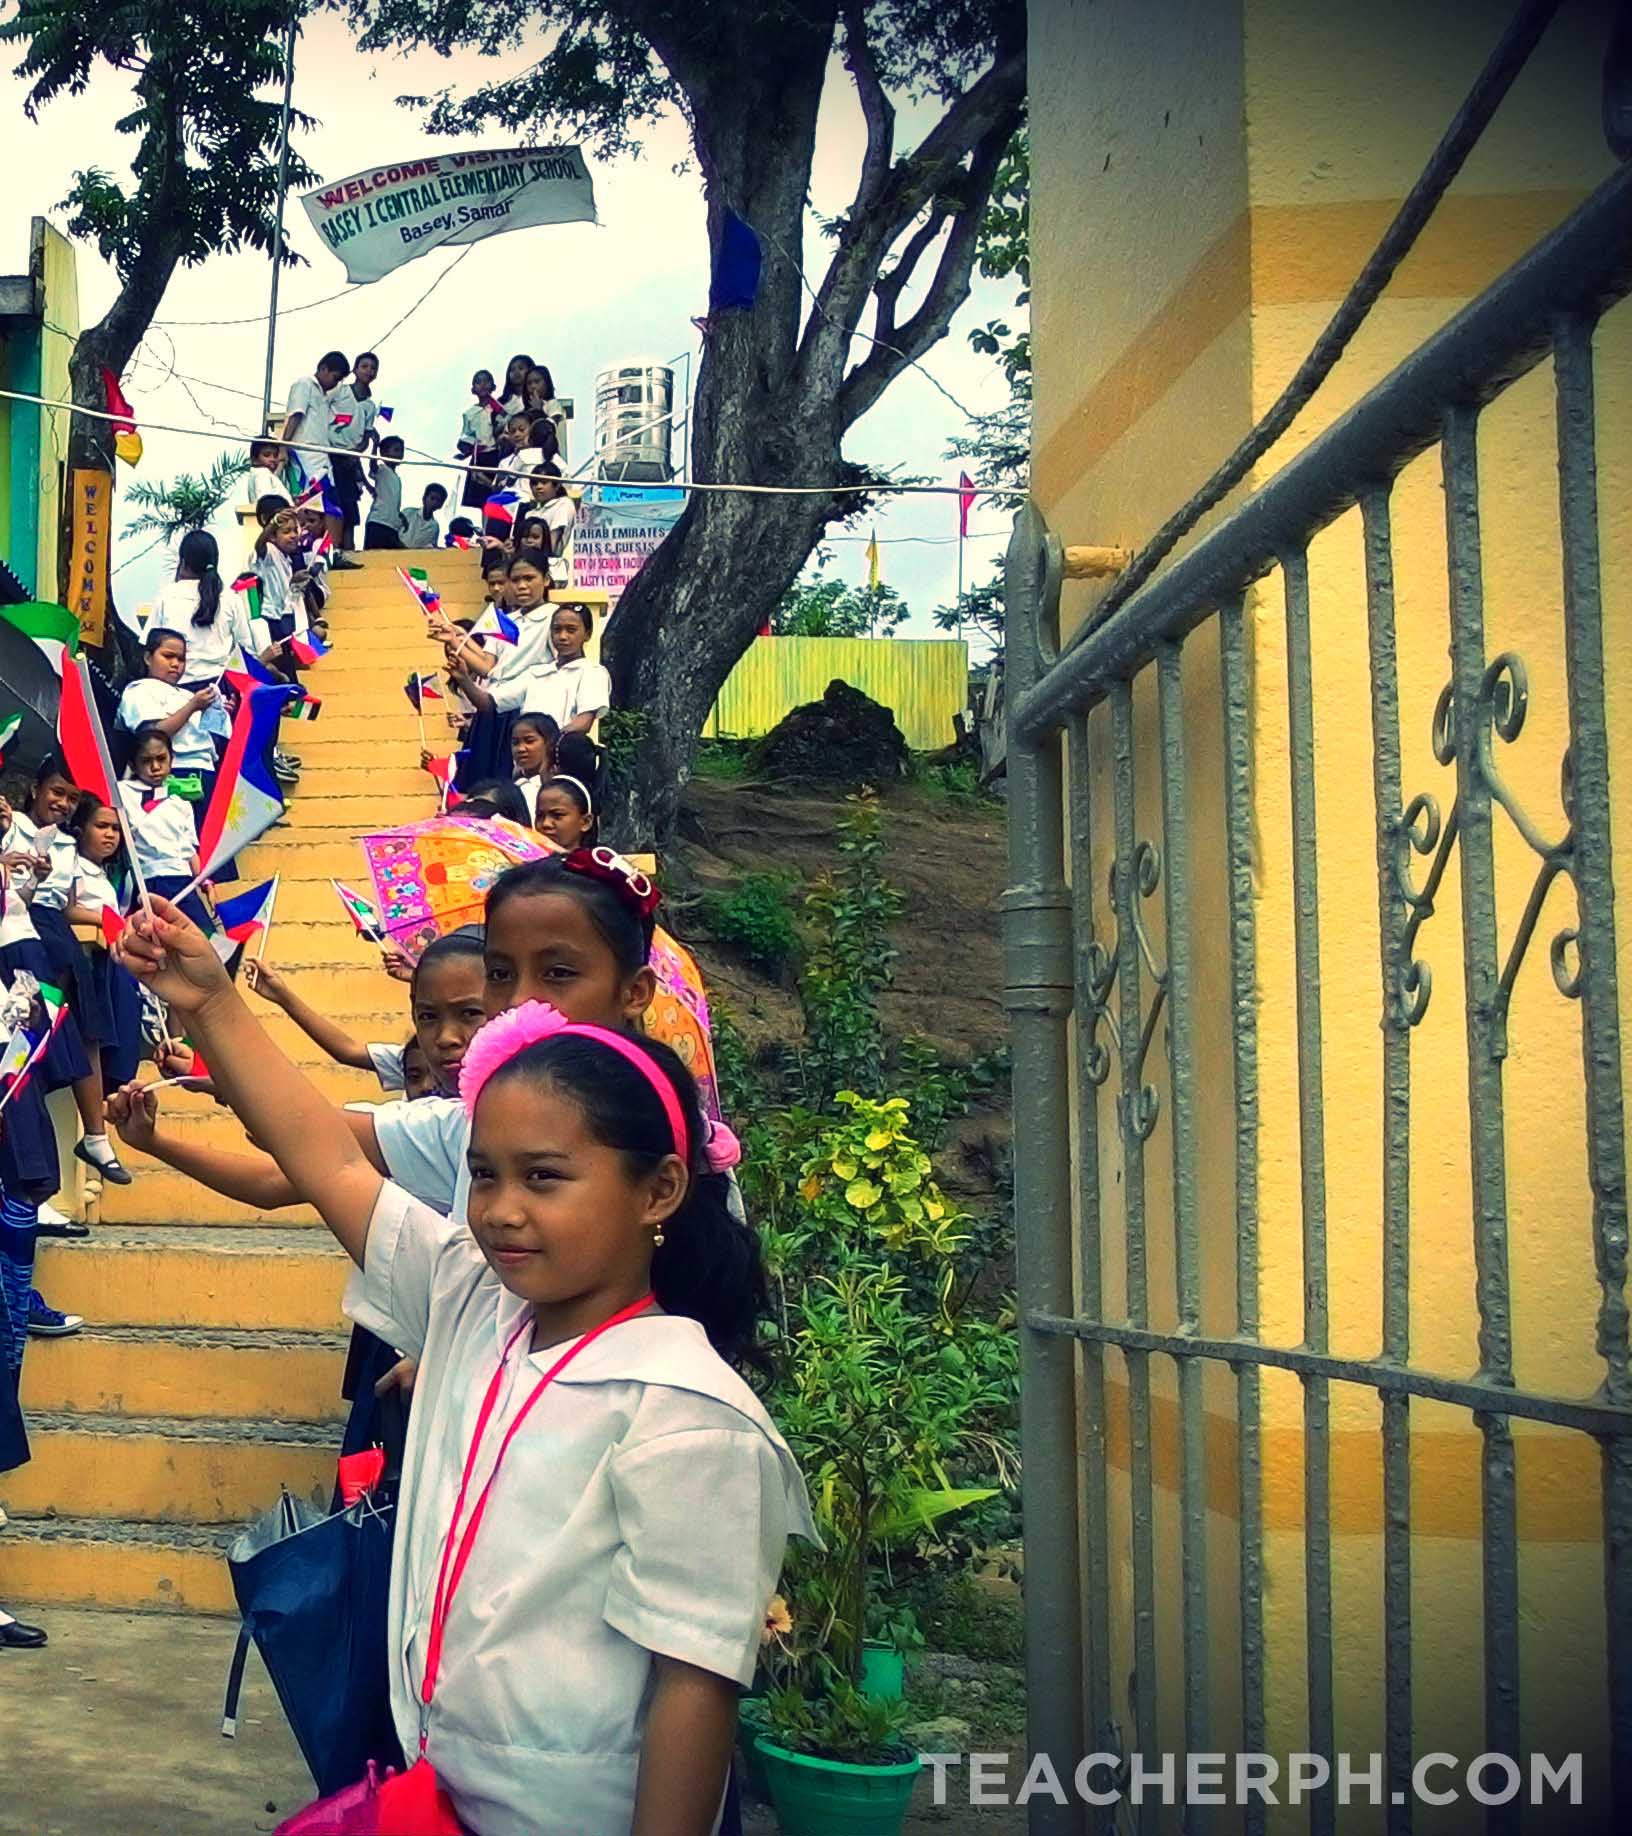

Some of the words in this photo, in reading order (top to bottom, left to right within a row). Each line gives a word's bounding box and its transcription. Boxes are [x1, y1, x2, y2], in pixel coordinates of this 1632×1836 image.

[317, 158, 441, 209] WELCOME
[321, 205, 363, 248] BASEY
[375, 182, 441, 223] CENTRAL
[440, 162, 526, 201] ELEMENTARY
[528, 157, 583, 182] SCHOOL
[399, 212, 456, 244] Basey,
[457, 199, 515, 224] Samar
[579, 528, 609, 539] ARAB
[612, 526, 666, 539] EMIRATES
